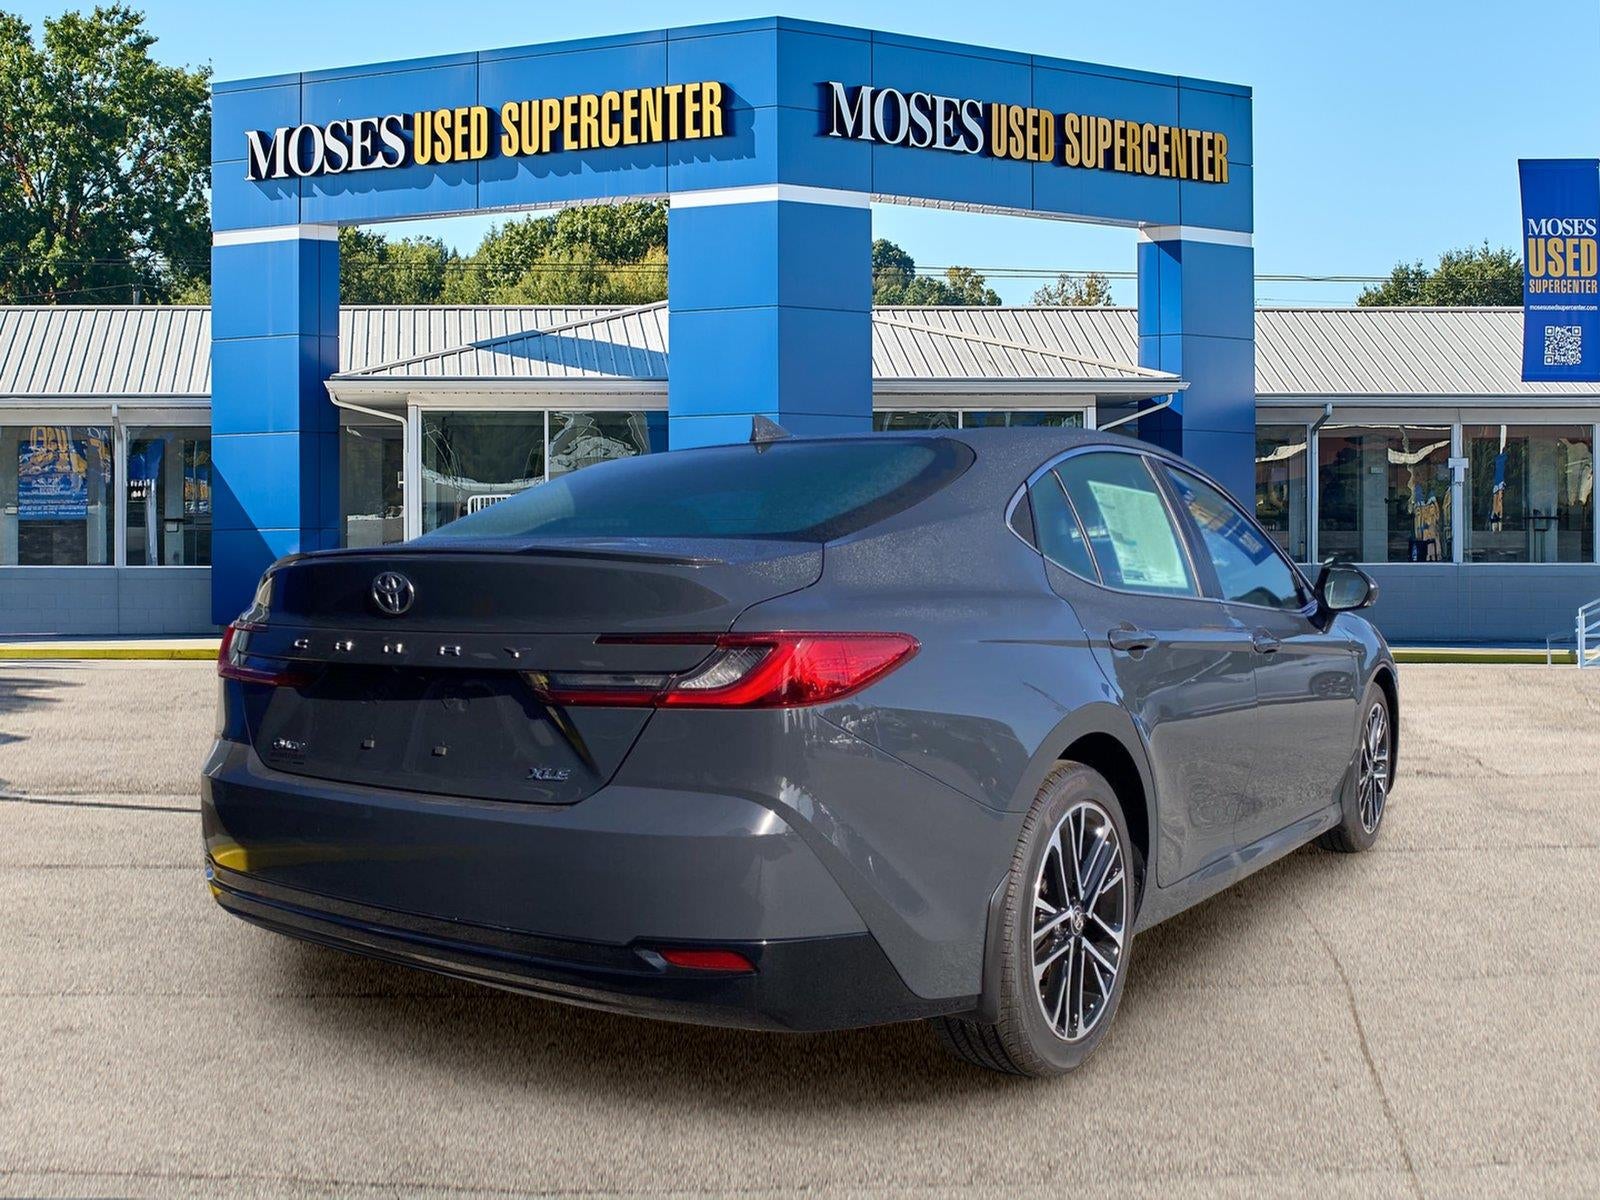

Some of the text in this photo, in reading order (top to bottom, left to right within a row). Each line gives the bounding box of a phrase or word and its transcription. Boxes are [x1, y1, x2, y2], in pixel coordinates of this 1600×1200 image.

[244, 82, 723, 181] MOSES USED SUPERCENTER
[829, 81, 1229, 183] MOSES USED SUPERCENTER
[1528, 218, 1596, 236] MOSES
[1527, 237, 1598, 278] USED
[1529, 279, 1598, 294] SUPERCENTER
